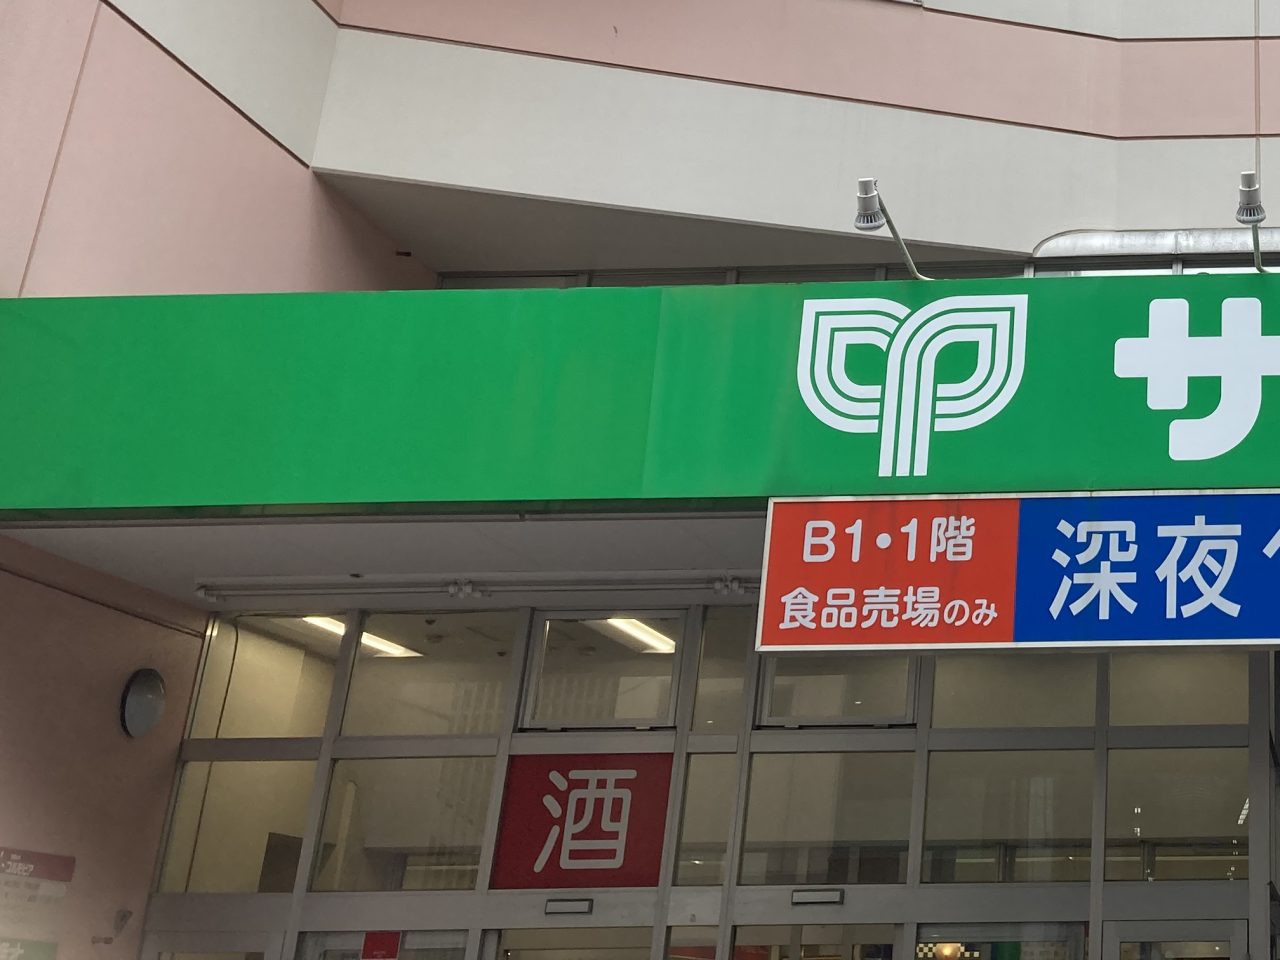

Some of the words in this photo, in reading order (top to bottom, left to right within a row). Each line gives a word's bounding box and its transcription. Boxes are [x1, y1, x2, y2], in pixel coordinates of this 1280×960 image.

[803, 516, 976, 563] B1・1階
[779, 587, 998, 629] 食品売場のみ
[533, 770, 637, 873] 酒
